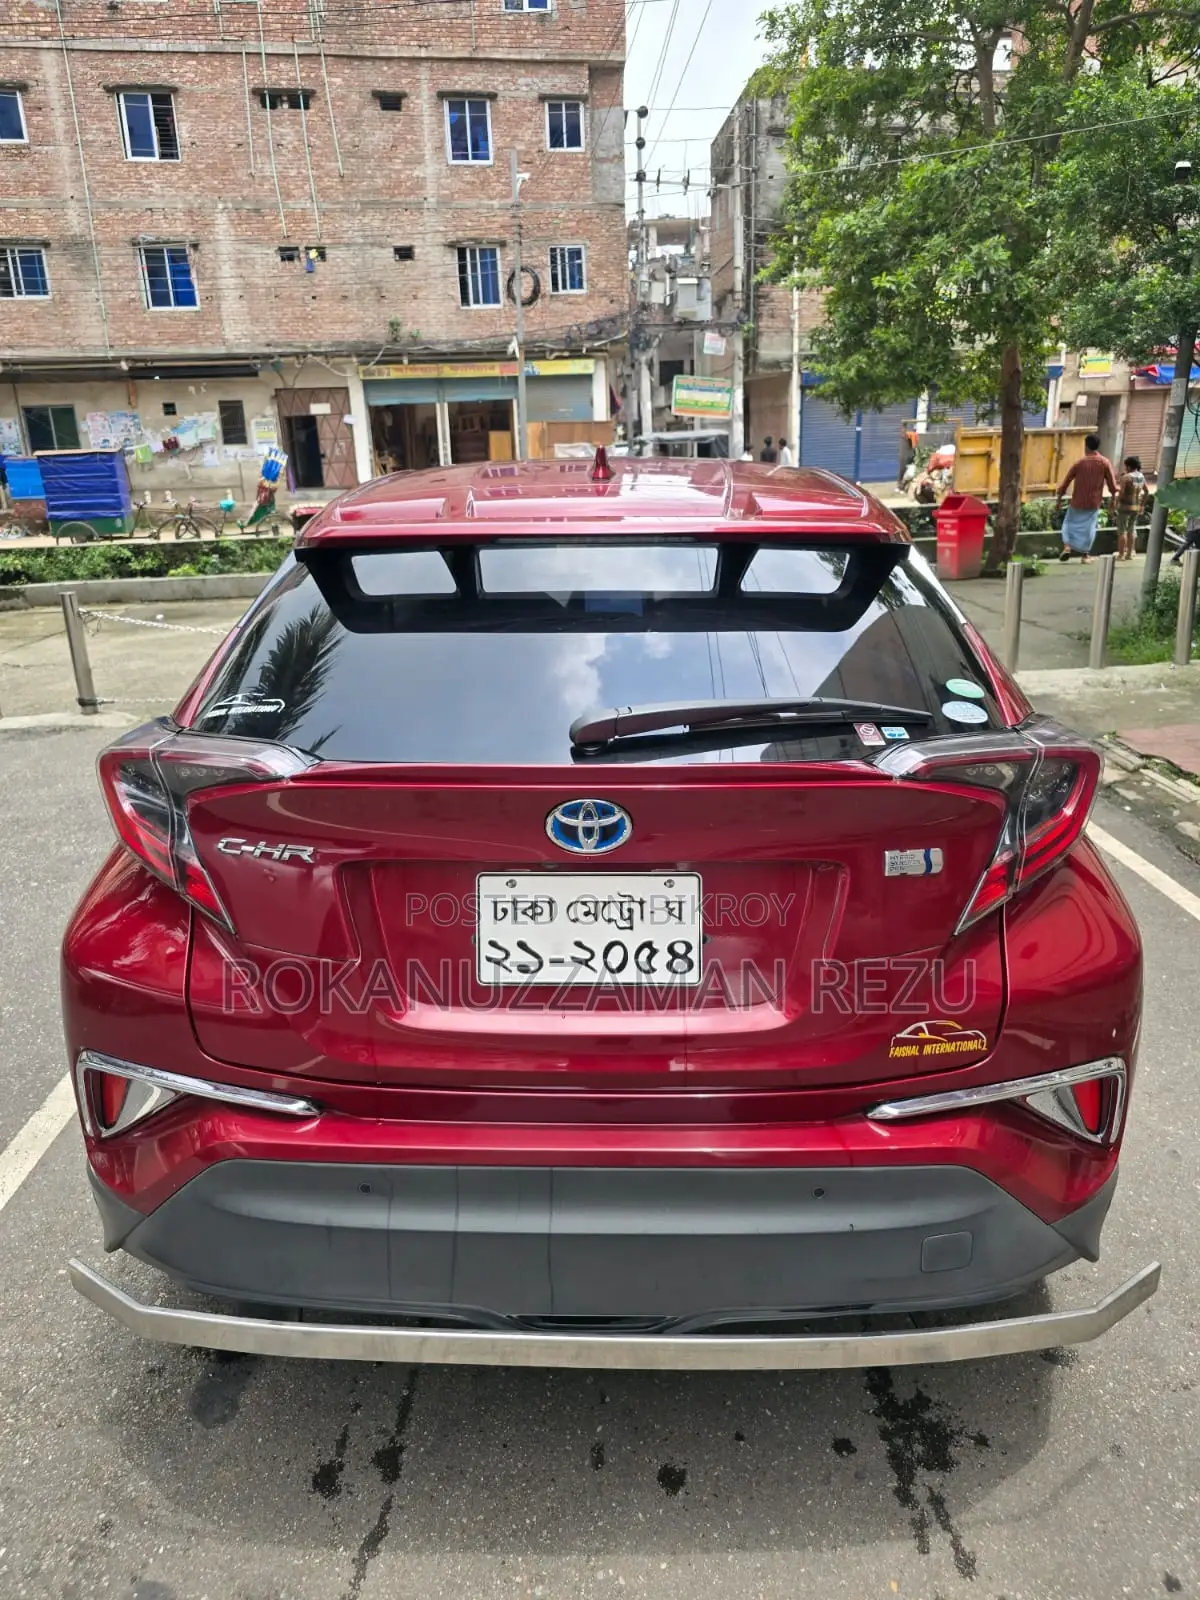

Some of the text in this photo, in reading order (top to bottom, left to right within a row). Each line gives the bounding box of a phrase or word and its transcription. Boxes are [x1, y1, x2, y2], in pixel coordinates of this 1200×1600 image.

[217, 837, 315, 864] C-HR
[490, 897, 556, 923] ঢাকা
[485, 939, 695, 975] ২১-২০৫৪
[889, 1039, 982, 1058] FAISHAL INTERNATIONAL
